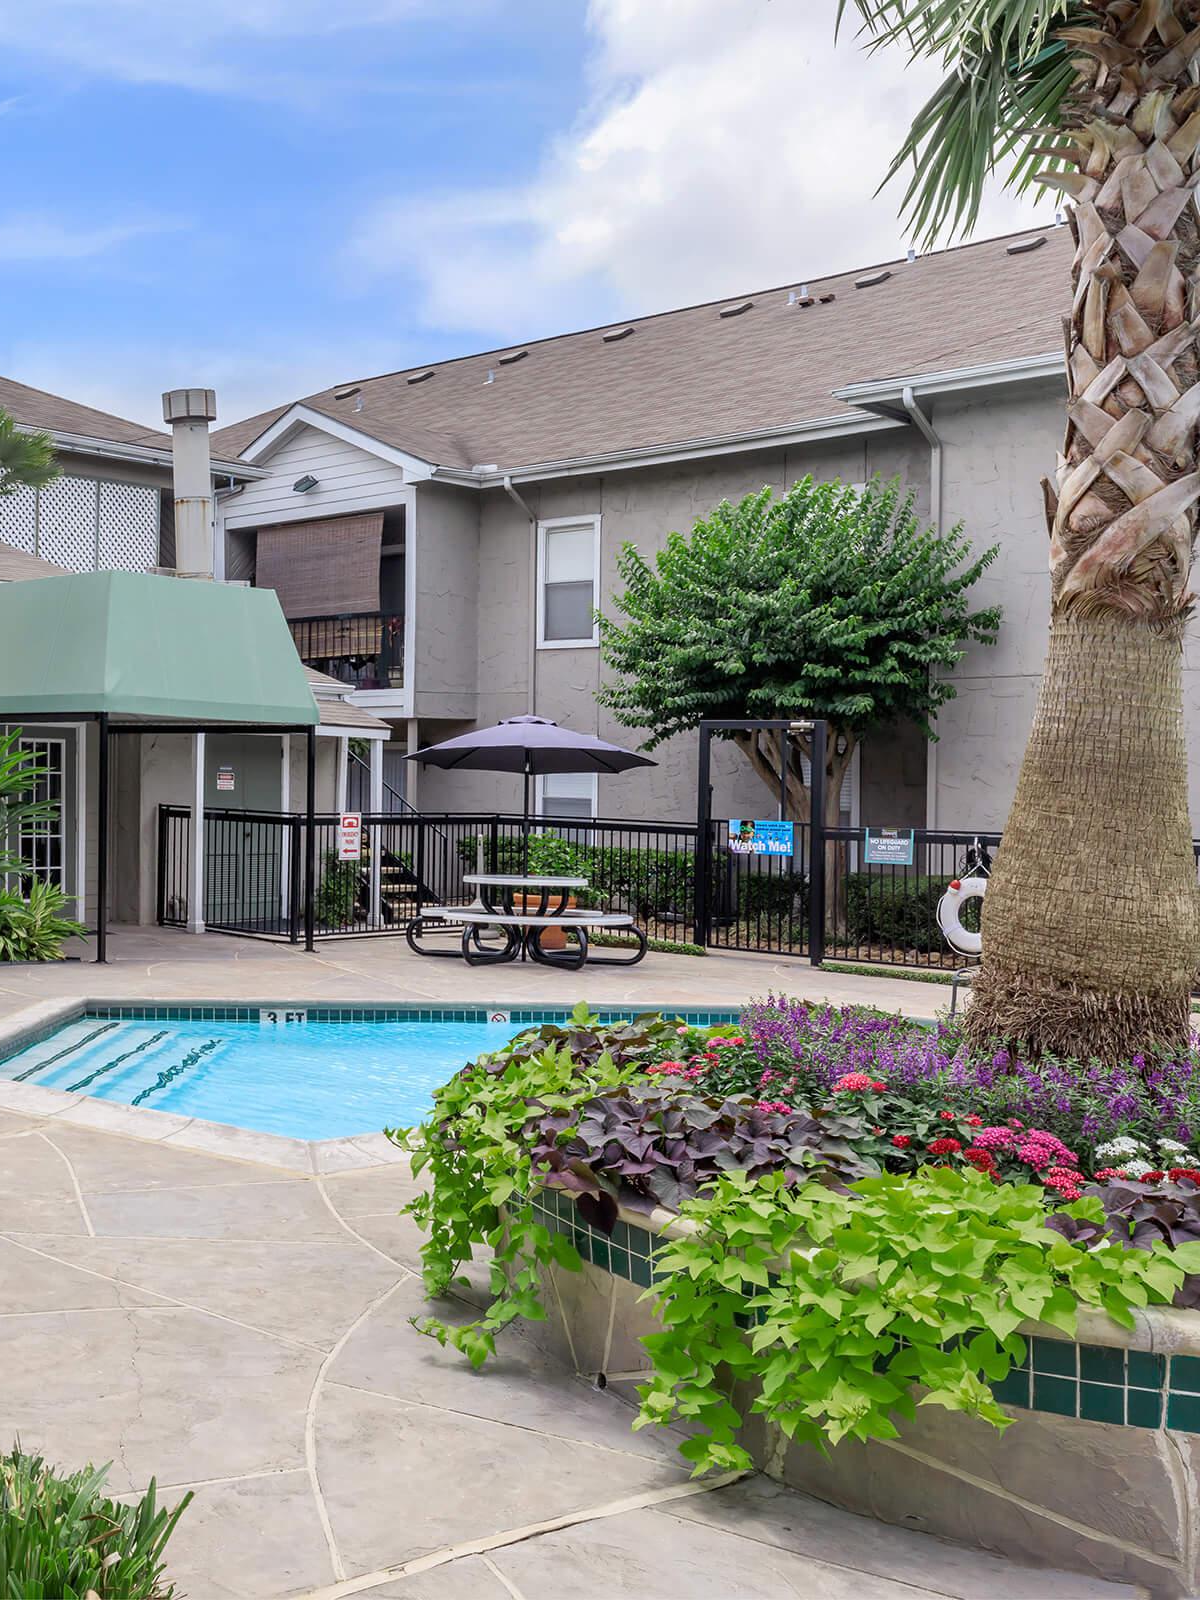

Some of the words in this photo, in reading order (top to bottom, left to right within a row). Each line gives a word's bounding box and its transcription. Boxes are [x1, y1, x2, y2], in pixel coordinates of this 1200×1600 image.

[728, 839, 766, 851] Watch
[768, 841, 791, 852] Me!
[267, 1011, 277, 1024] 3
[285, 1012, 305, 1023] FT
